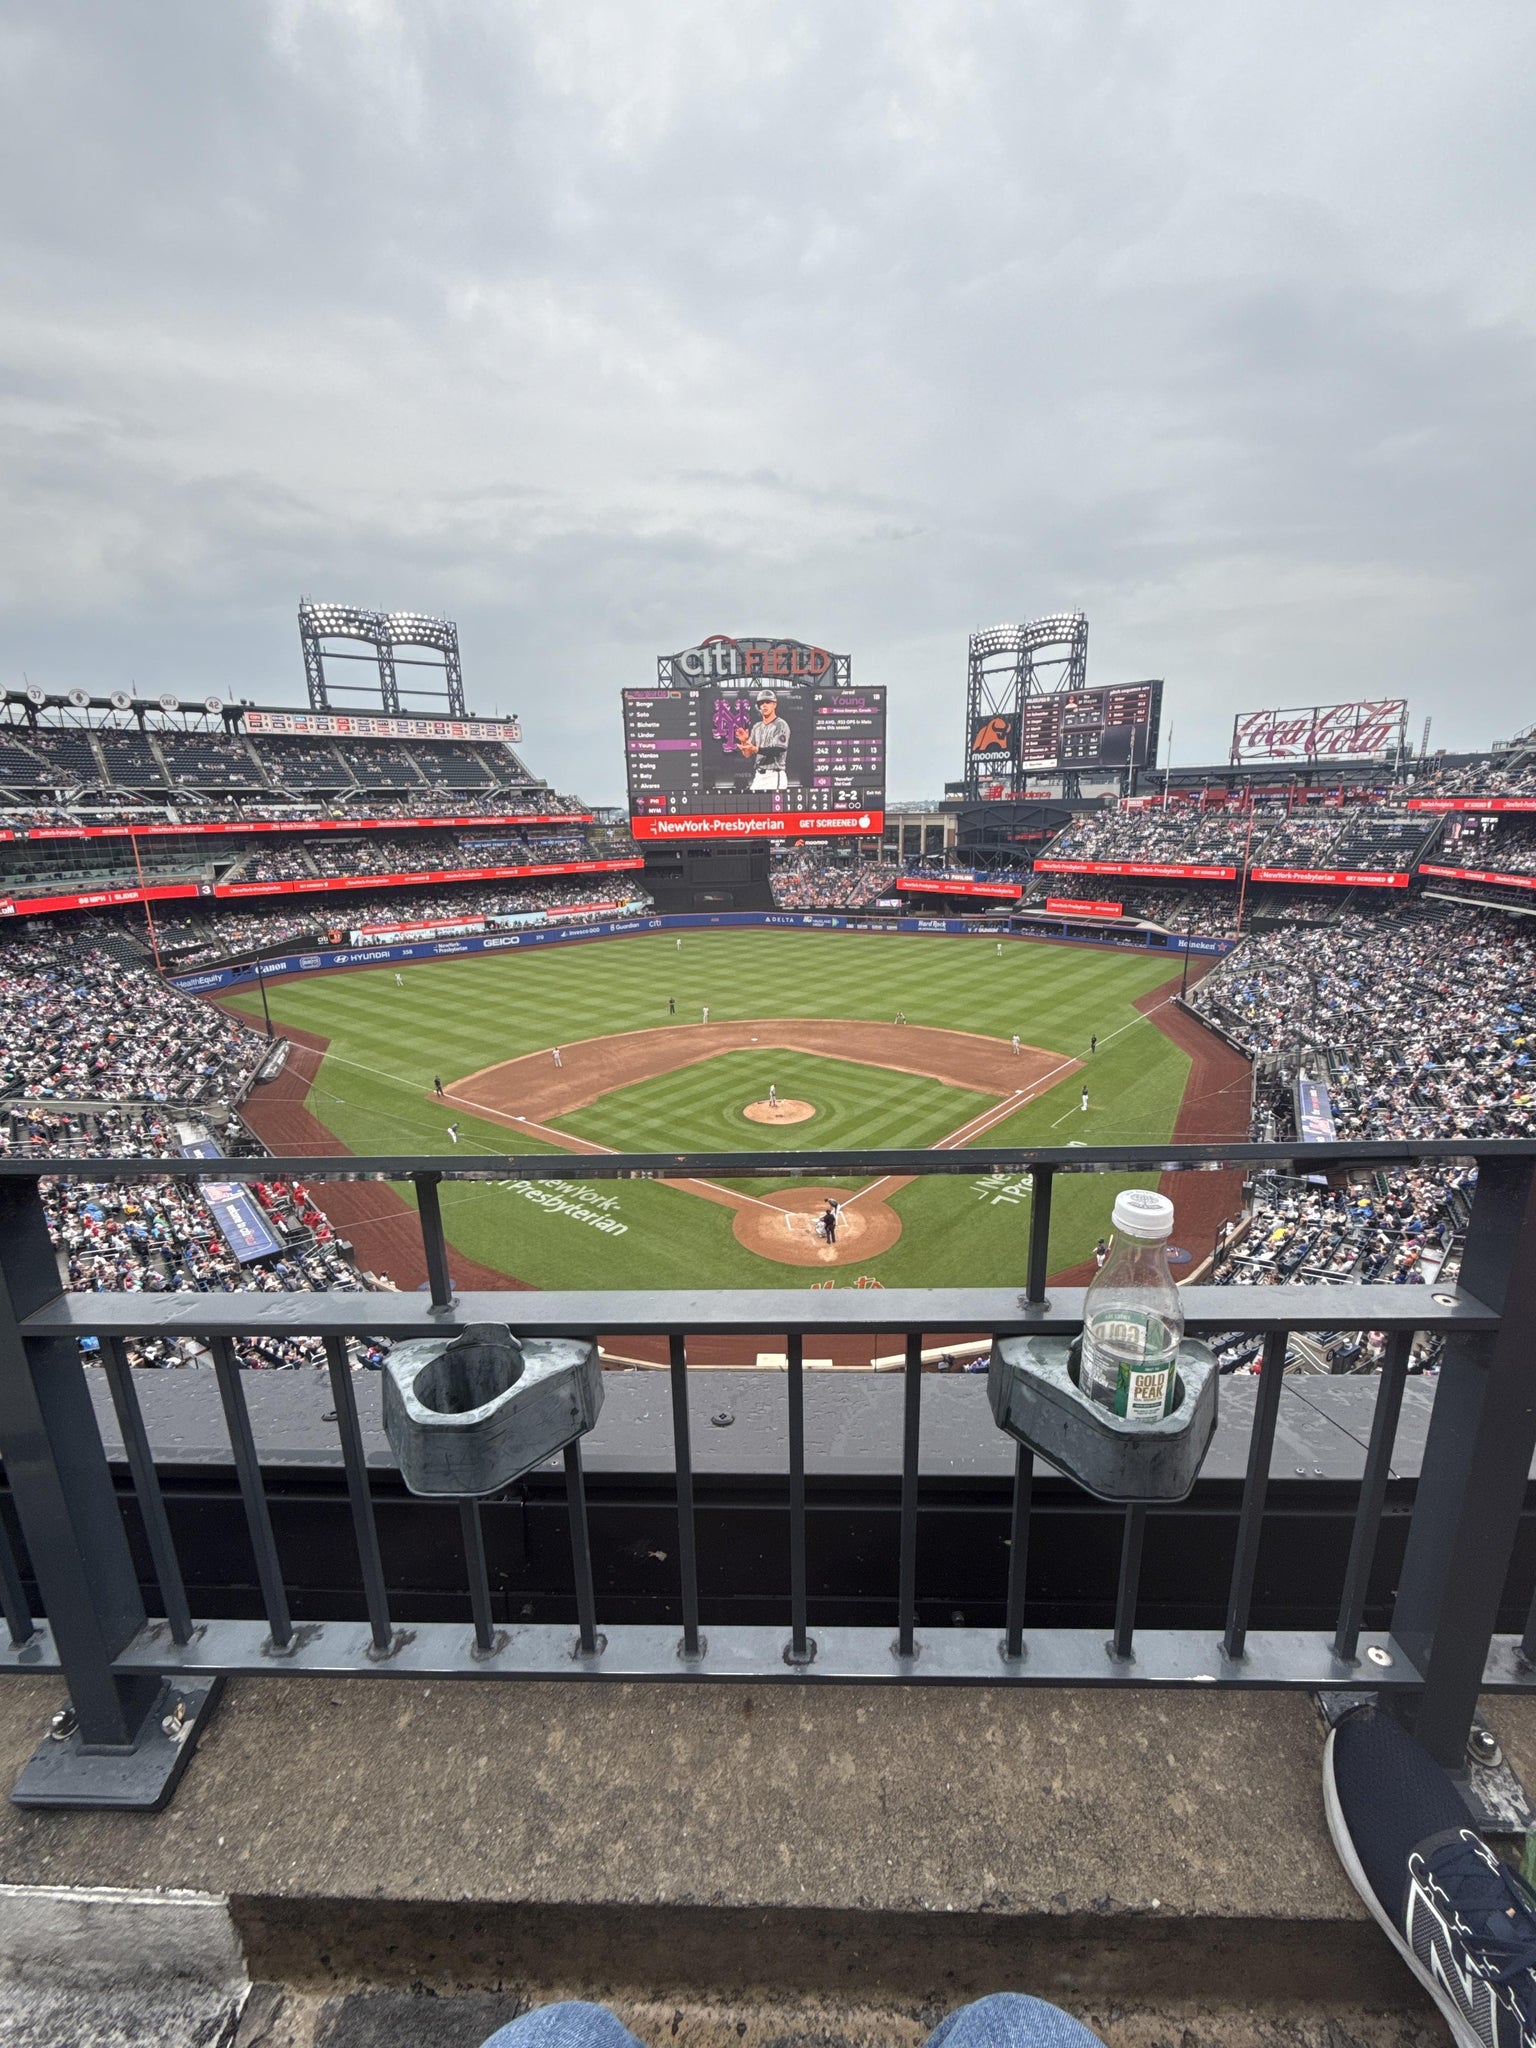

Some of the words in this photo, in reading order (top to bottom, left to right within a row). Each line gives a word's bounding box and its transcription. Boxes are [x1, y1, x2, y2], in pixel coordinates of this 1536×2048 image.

[681, 638, 737, 675] citi
[745, 648, 830, 675] FIELD
[31, 690, 41, 699] 37
[209, 701, 220, 709] 42
[831, 696, 865, 707] Young
[1231, 699, 1405, 758] Coca-Cola
[972, 751, 1010, 760] moomoo
[838, 790, 857, 800] 2-2
[1022, 790, 1052, 799] balance
[658, 818, 784, 833] NewYork-Presbyterian
[800, 820, 814, 828] GET
[816, 819, 857, 828] SCREENED
[1262, 872, 1336, 882] NewYork-Presbyterian
[202, 886, 211, 894] 3
[616, 922, 639, 930] Guardian
[649, 917, 662, 928] citi
[483, 936, 519, 948] GEICO
[350, 951, 390, 961] HYUNDAI
[255, 962, 286, 974] Canon
[176, 974, 223, 987] HealthEquity
[538, 1180, 621, 1210] ewYork-
[506, 1180, 628, 1236] Presbyterian
[1135, 1374, 1165, 1387] GOLD
[1134, 1385, 1162, 1399] PEAK
